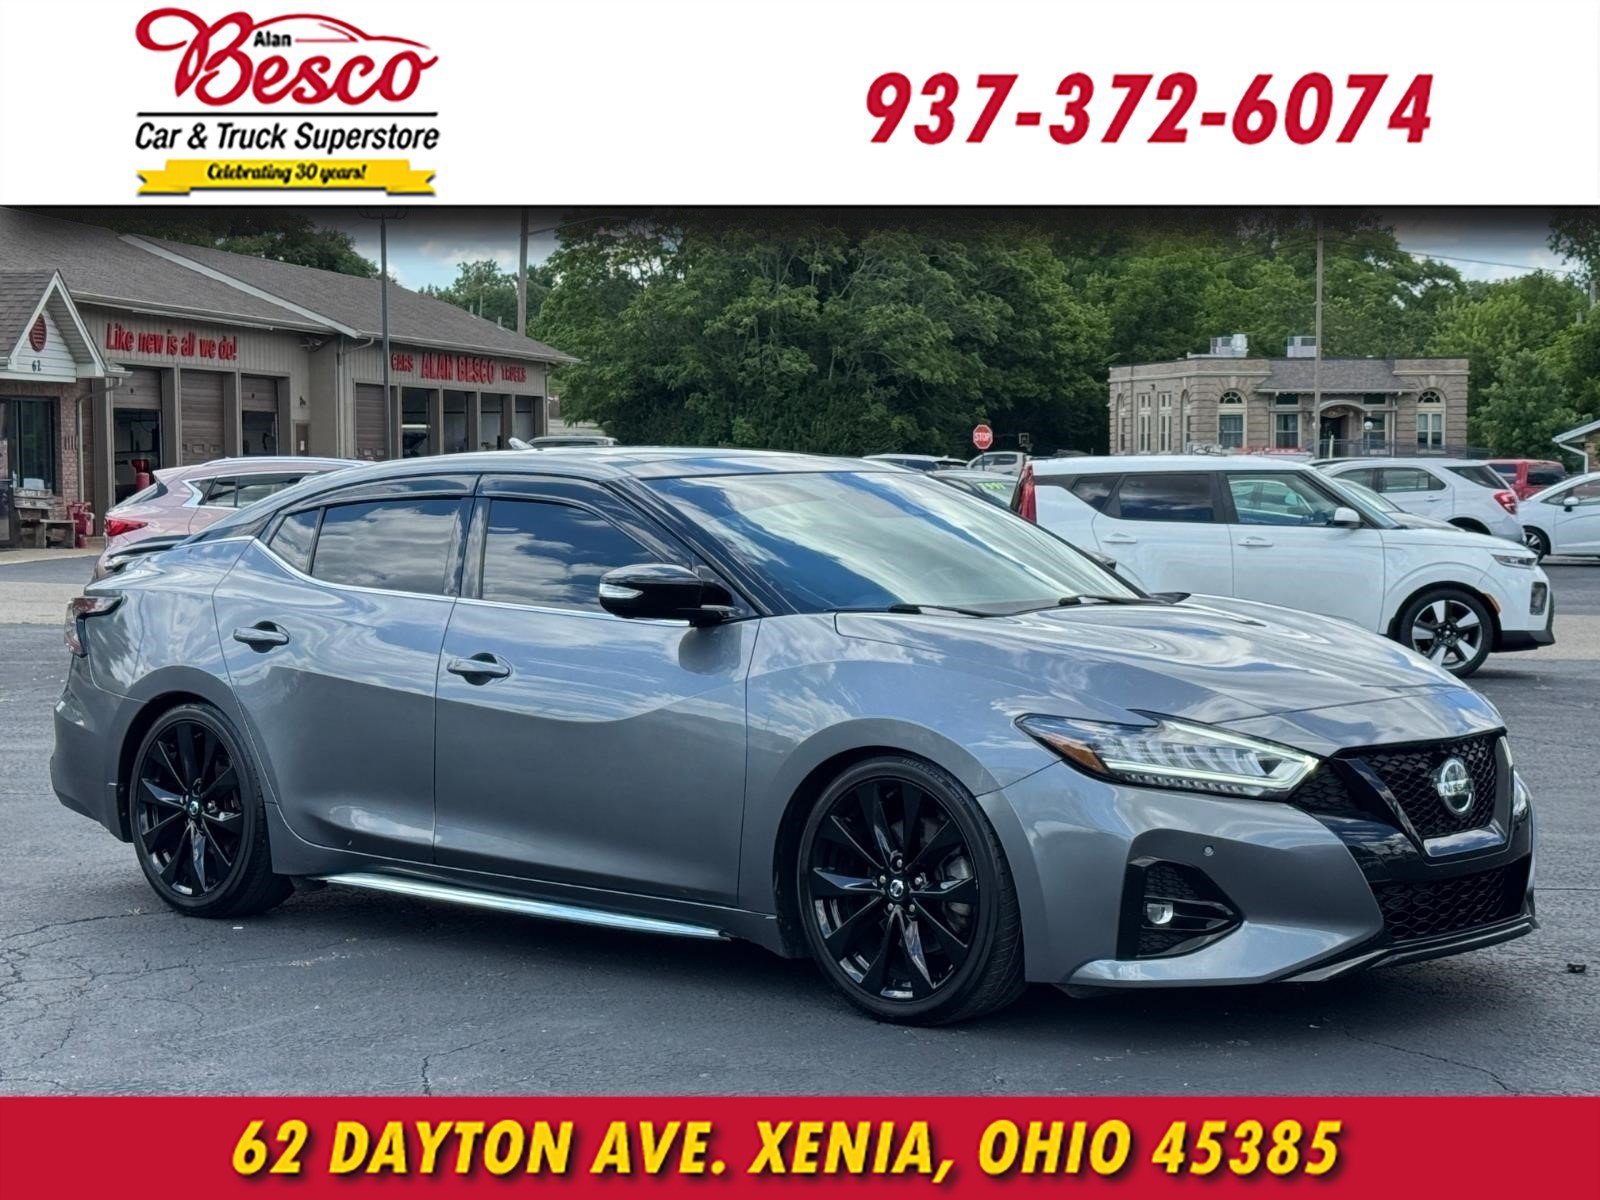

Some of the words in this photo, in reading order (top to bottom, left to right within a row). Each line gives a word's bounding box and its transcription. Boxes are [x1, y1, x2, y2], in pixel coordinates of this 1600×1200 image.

[106, 322, 134, 352] Like
[138, 332, 163, 355] new
[166, 328, 177, 356] is
[181, 331, 195, 357] all
[200, 338, 216, 359] we
[218, 335, 237, 360] do!
[421, 352, 453, 381] ALAN
[456, 355, 495, 384] BESCO
[974, 431, 991, 442] STOP
